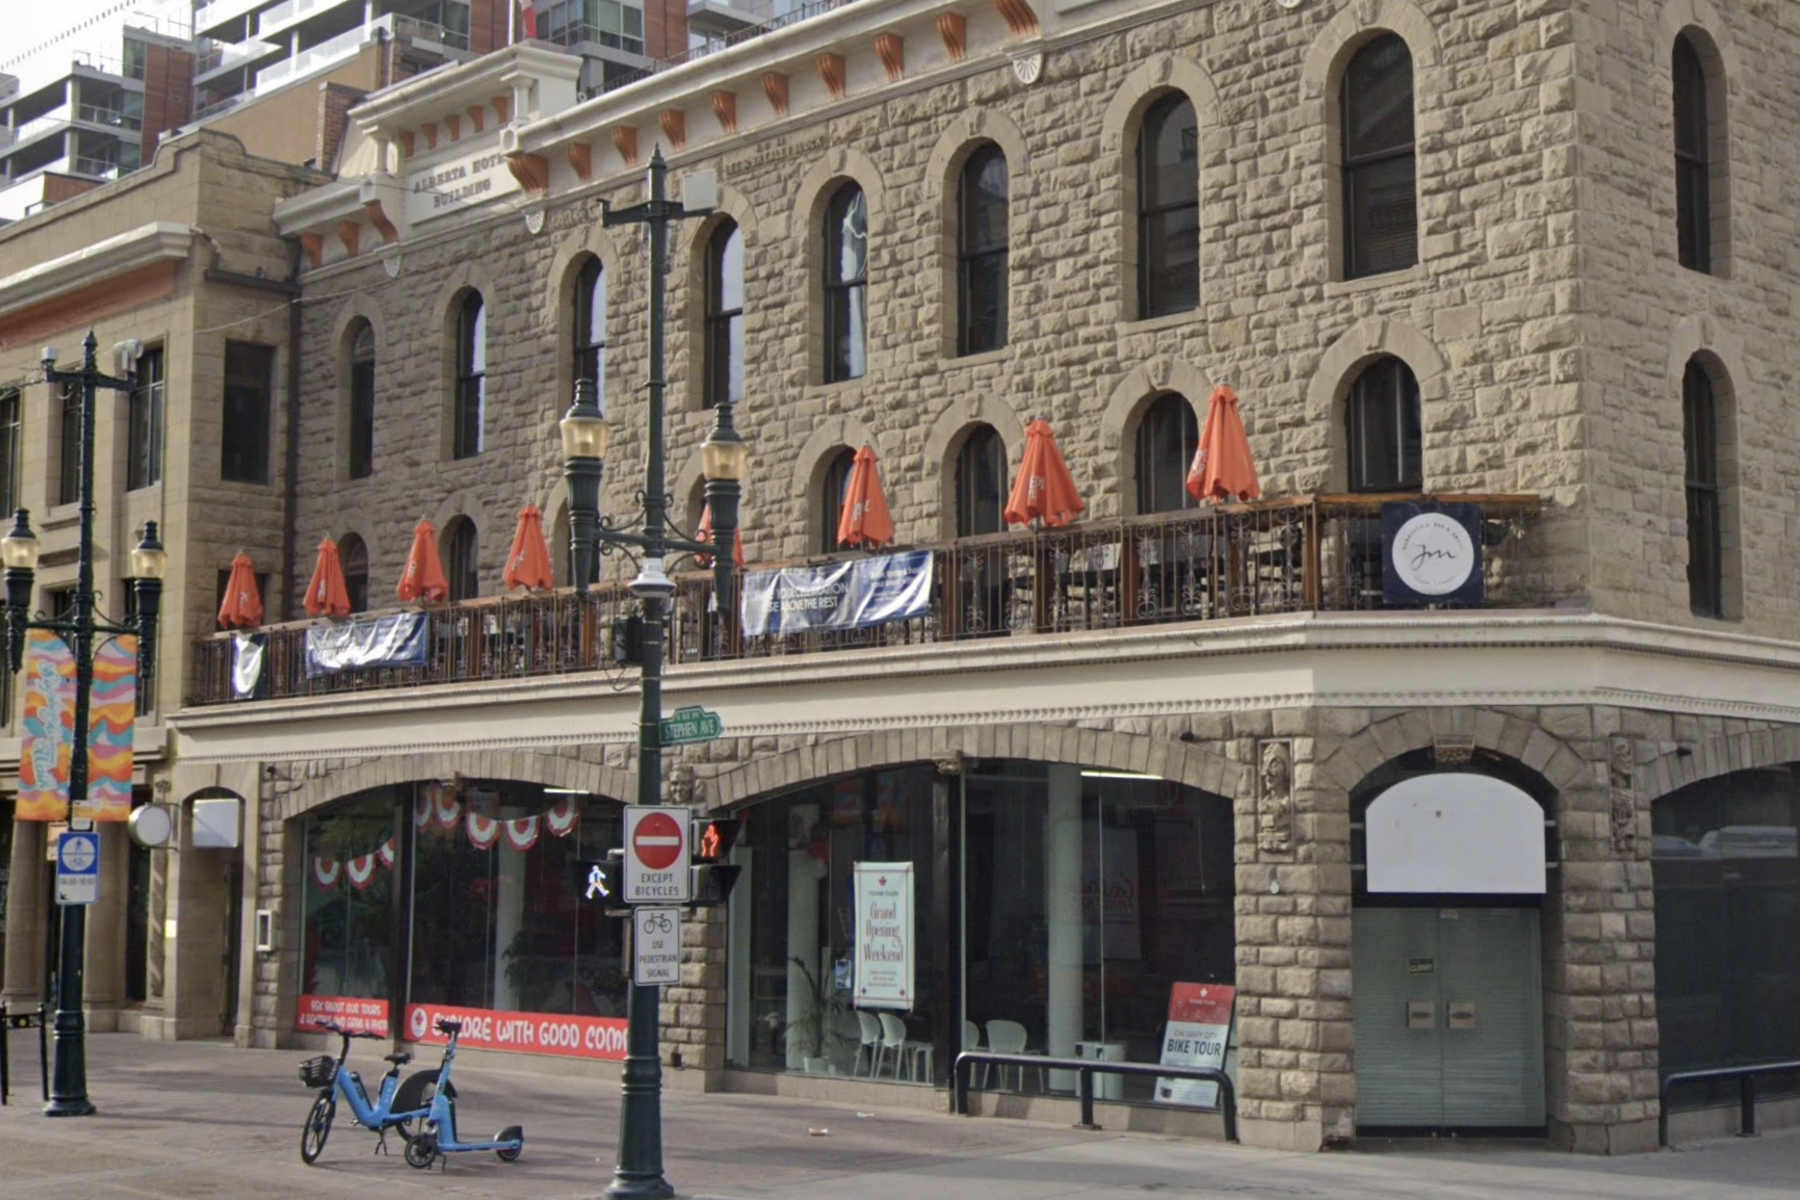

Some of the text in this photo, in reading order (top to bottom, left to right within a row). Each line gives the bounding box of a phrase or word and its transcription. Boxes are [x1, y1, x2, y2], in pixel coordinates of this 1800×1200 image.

[414, 166, 467, 194] ALBERTA
[434, 178, 491, 208] BUILDING
[804, 598, 818, 610] THE
[818, 596, 838, 608] REST
[665, 719, 714, 739] STEPHEN AVE
[641, 873, 673, 884] EXCEPT
[635, 886, 679, 896] BICYCLES
[870, 901, 896, 920] Grand
[866, 919, 900, 948] Opening
[652, 940, 664, 950] USE
[863, 942, 904, 962] Weekend
[640, 954, 678, 964] PEDESTRIAN
[646, 968, 670, 978] SIGNAL
[346, 1002, 360, 1014] OUR
[361, 1003, 381, 1016] TOURS
[496, 1019, 534, 1044] WITH
[539, 1022, 580, 1048] GOOD
[1174, 1029, 1218, 1039] CALGARY CITY
[1167, 1038, 1222, 1056] BIKE TOUR
